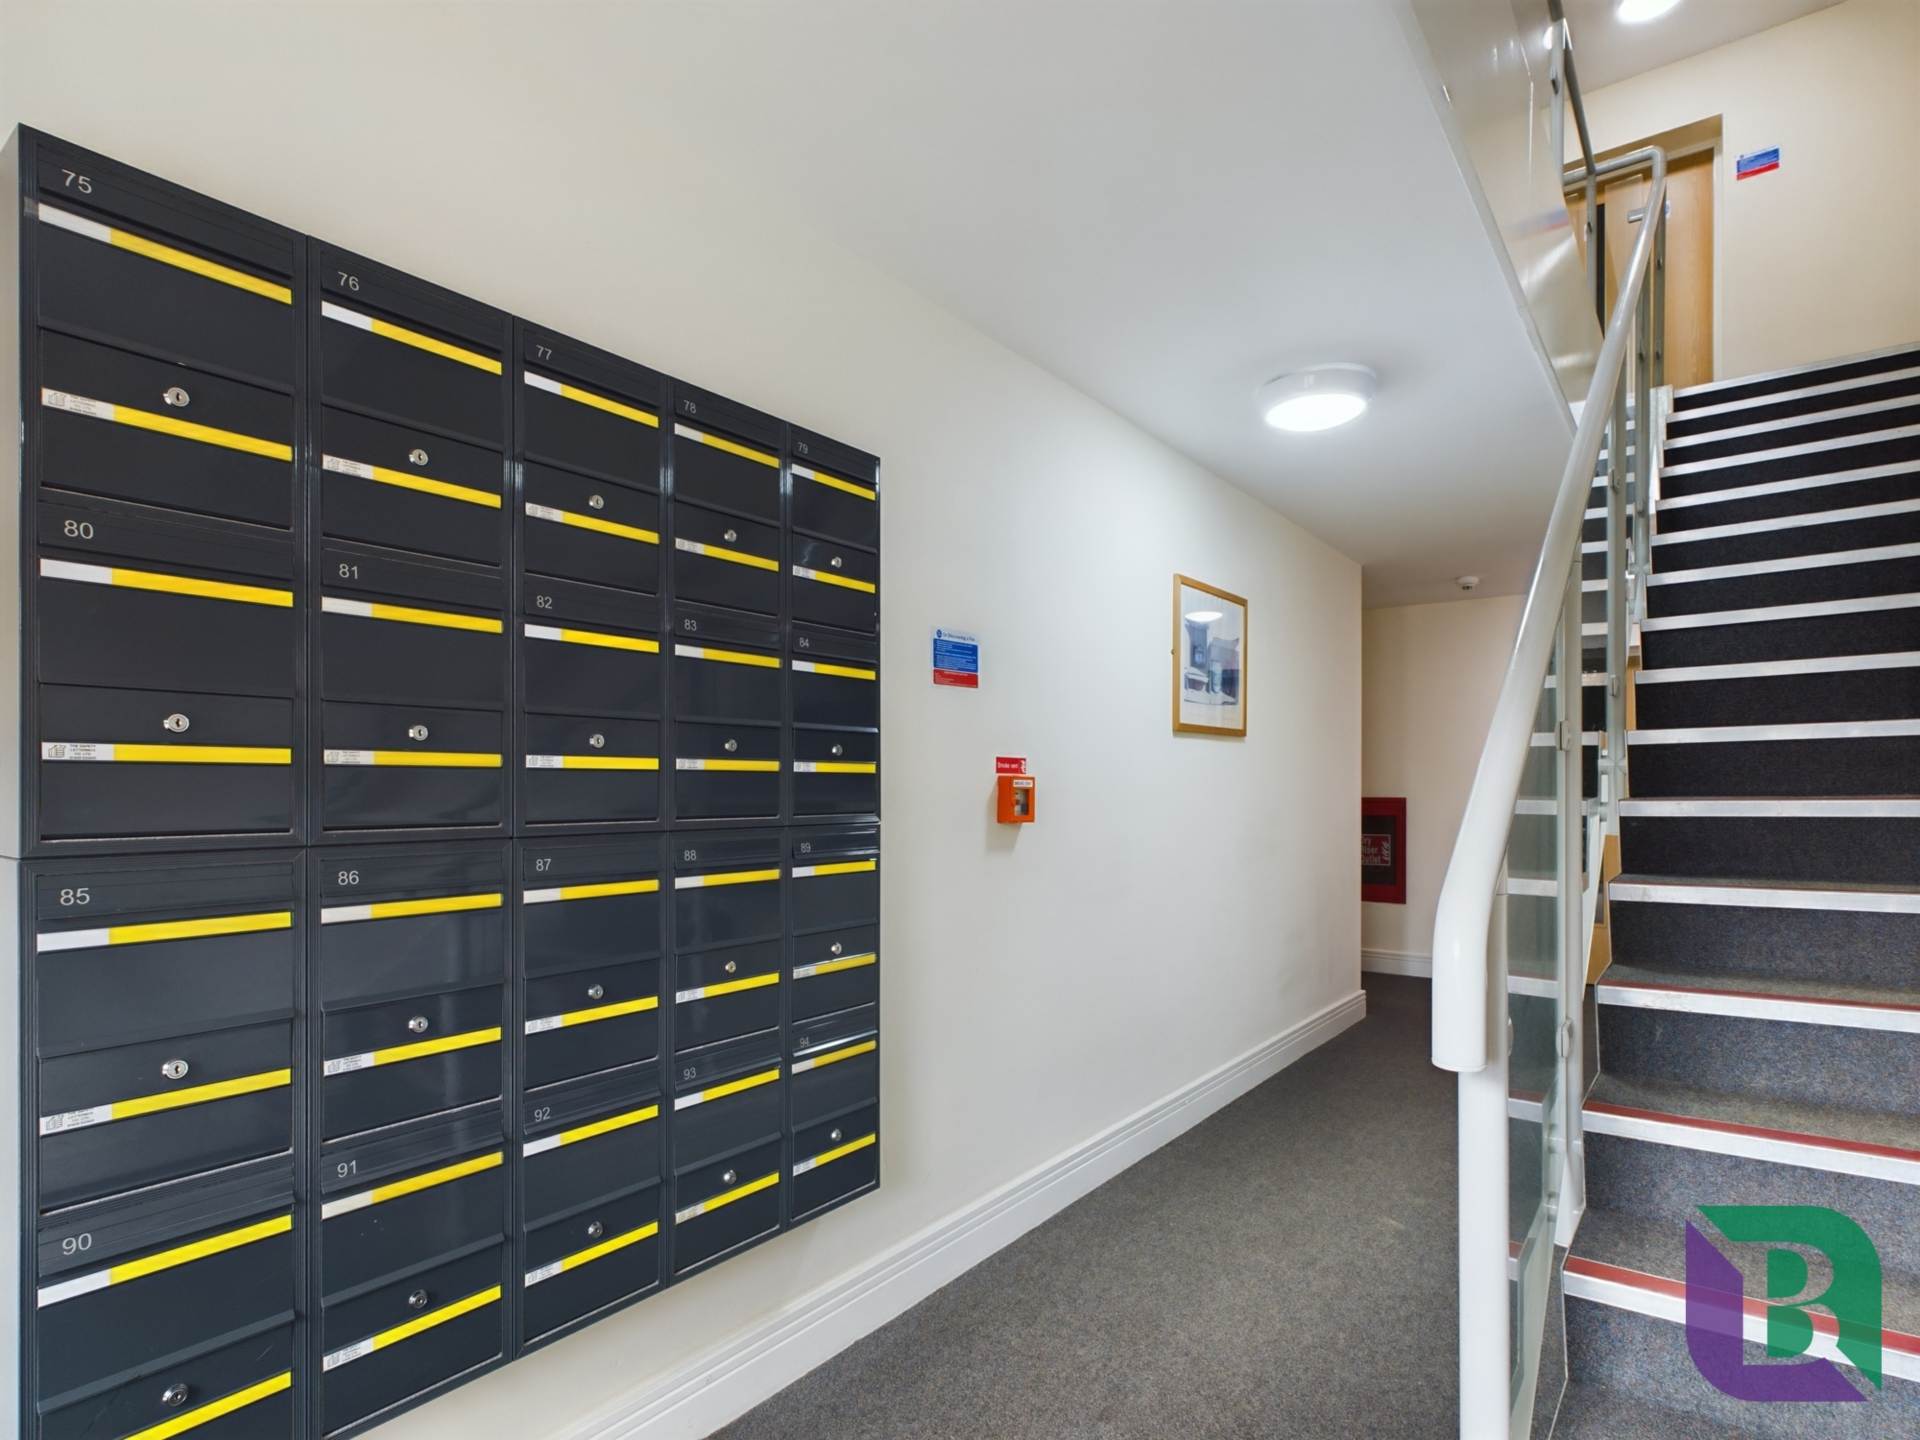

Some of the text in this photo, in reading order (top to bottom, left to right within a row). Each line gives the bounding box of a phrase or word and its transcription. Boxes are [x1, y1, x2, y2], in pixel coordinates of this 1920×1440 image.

[62, 168, 91, 193] 75
[338, 272, 359, 290] 76
[536, 344, 552, 360] 77
[684, 399, 696, 413] 78
[798, 441, 808, 454] 79
[64, 520, 93, 539] 80
[339, 564, 357, 579] 81
[537, 595, 552, 609] 82
[685, 618, 696, 631] 83
[800, 637, 809, 647] 84
[684, 849, 696, 861] 88
[536, 859, 551, 871] 87
[338, 871, 359, 885] 86
[61, 888, 89, 905] 85
[800, 1036, 809, 1048] 94
[684, 1066, 696, 1080] 93
[535, 1107, 550, 1122] 92
[337, 1160, 356, 1177] 91
[63, 1233, 91, 1255] 90
